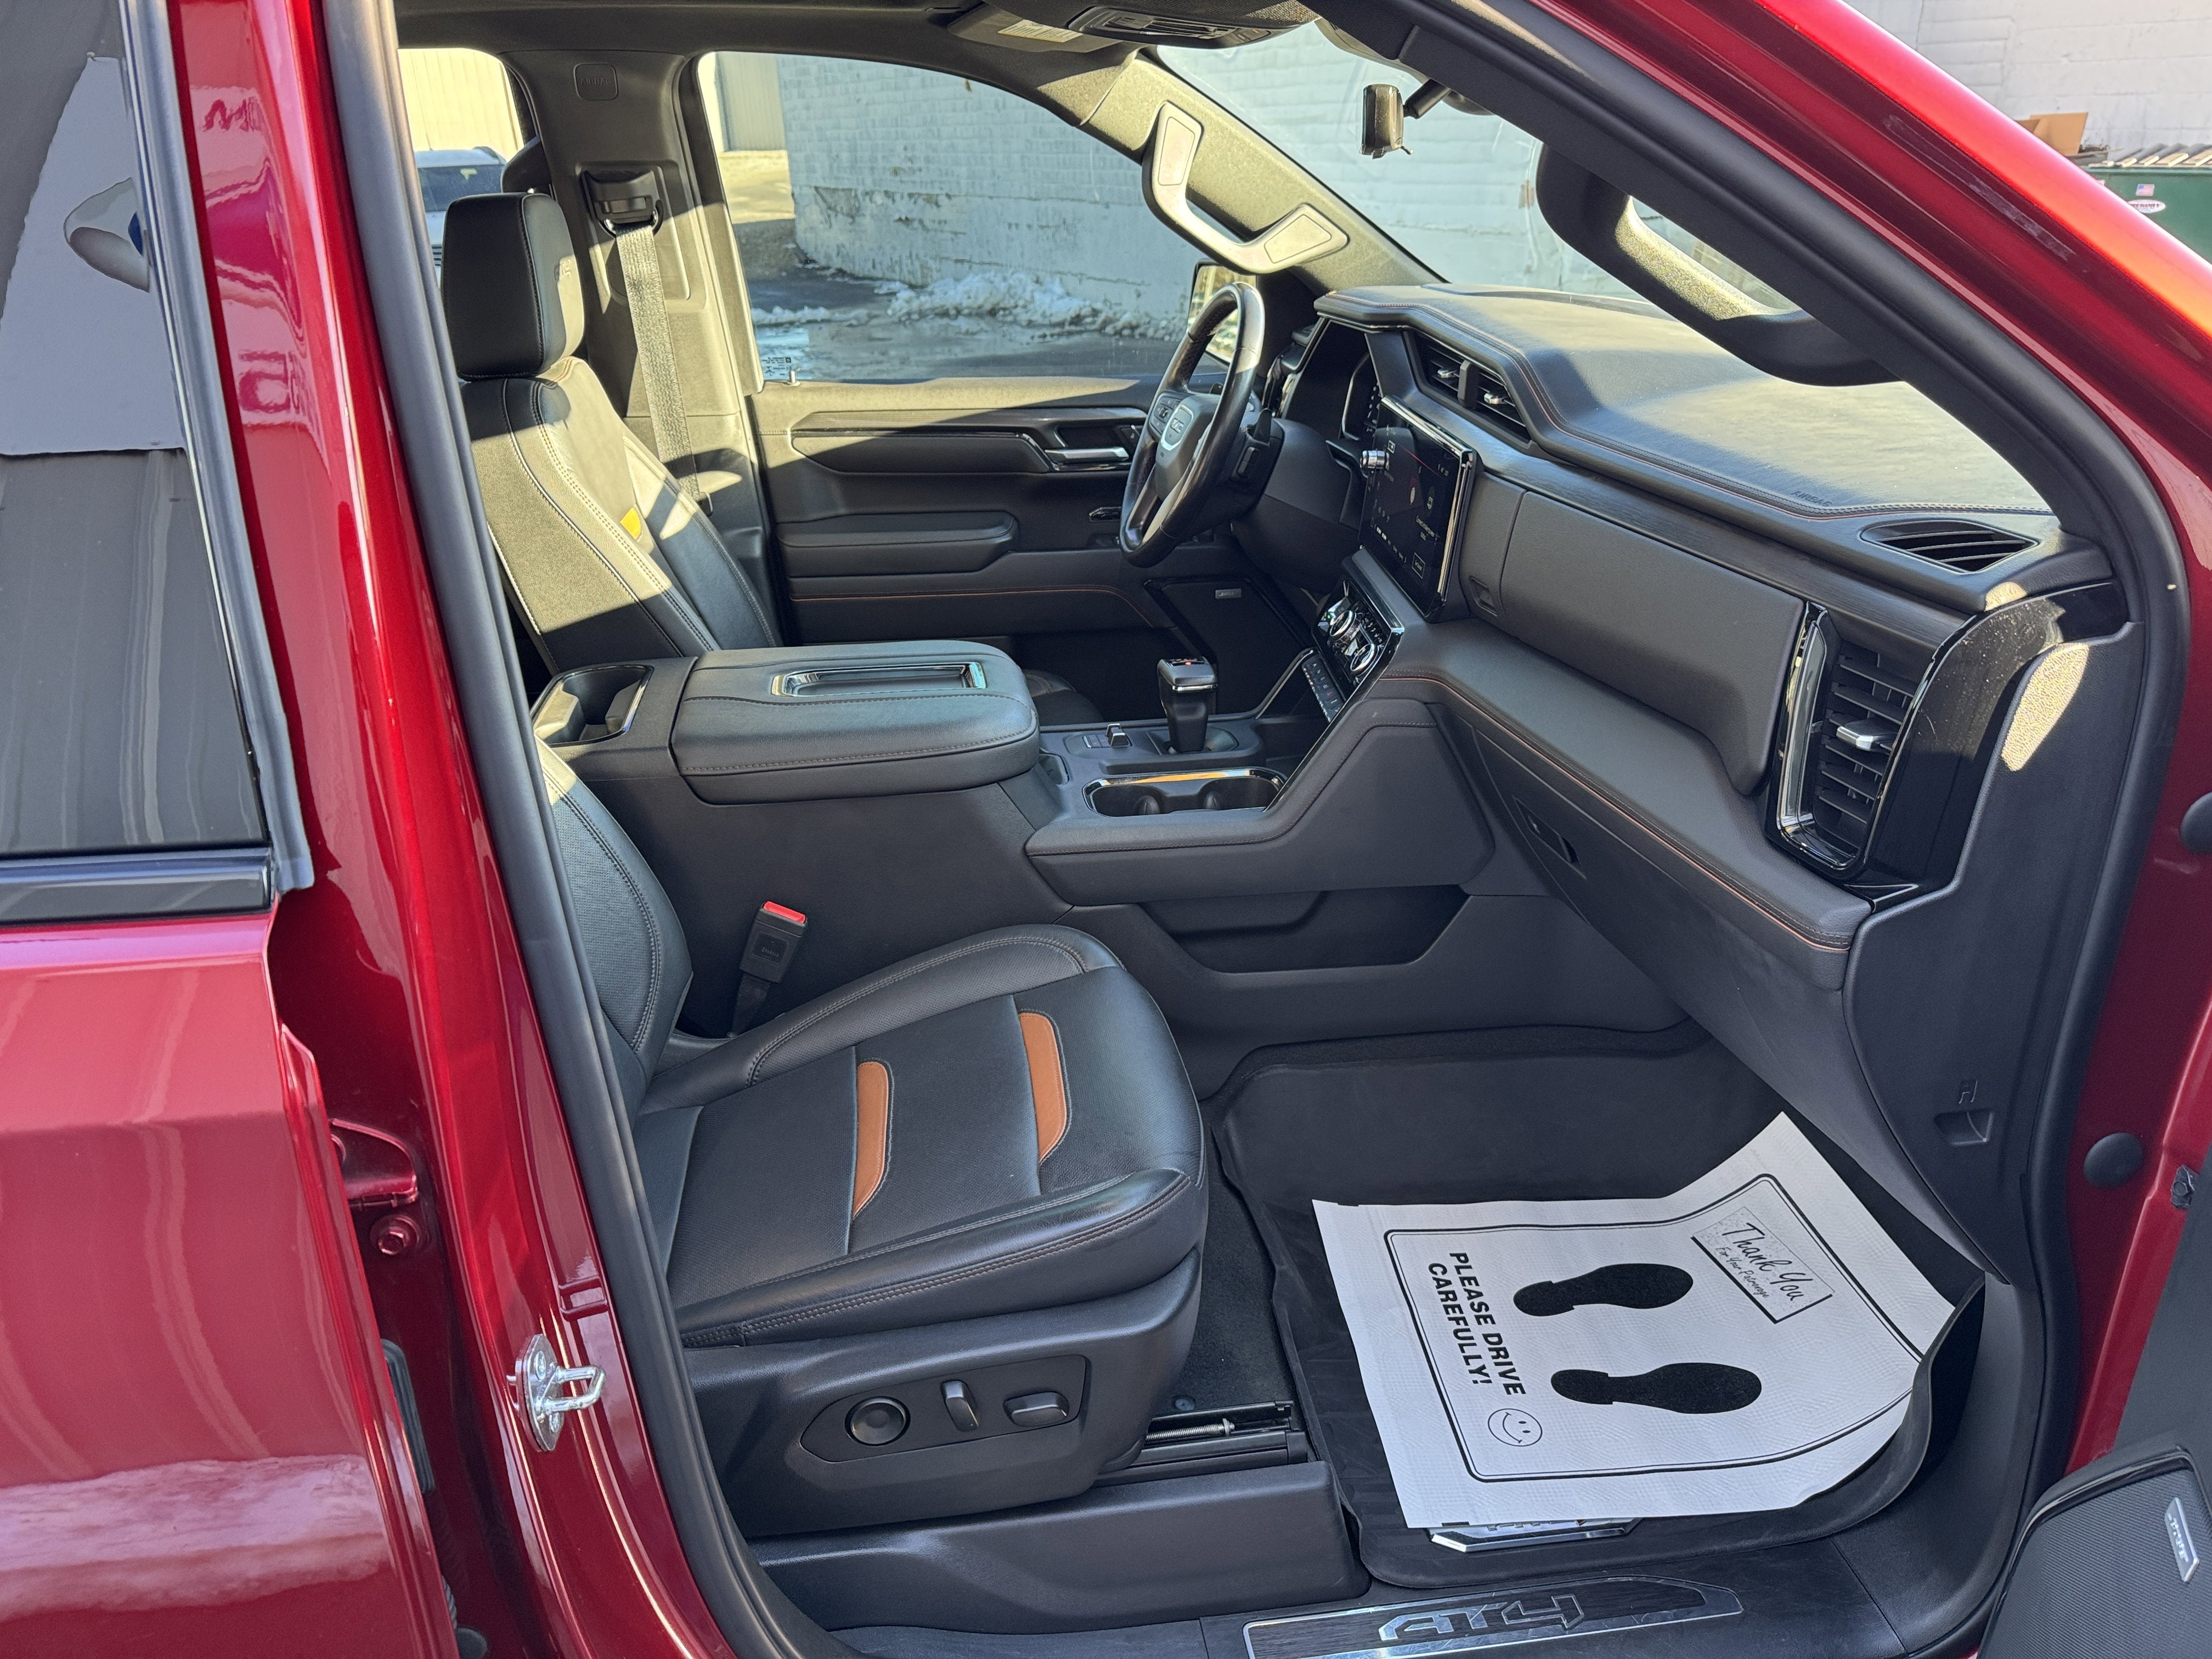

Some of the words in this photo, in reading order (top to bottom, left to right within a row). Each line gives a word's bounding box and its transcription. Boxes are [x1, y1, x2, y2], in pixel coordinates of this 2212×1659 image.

[1791, 490, 1833, 507] AIRBAG
[1715, 1246, 1732, 1257] For
[1726, 1257, 1742, 1270] Your
[1739, 1269, 1769, 1299] Patronage
[1722, 1222, 1793, 1272] Thank
[1769, 1272, 1813, 1301] You
[1428, 1263, 1493, 1384] CAREFULLY!
[1449, 1252, 1496, 1325] PLEASE
[1481, 1333, 1527, 1395] DRIVE
[1378, 1594, 1585, 1641] AT4
